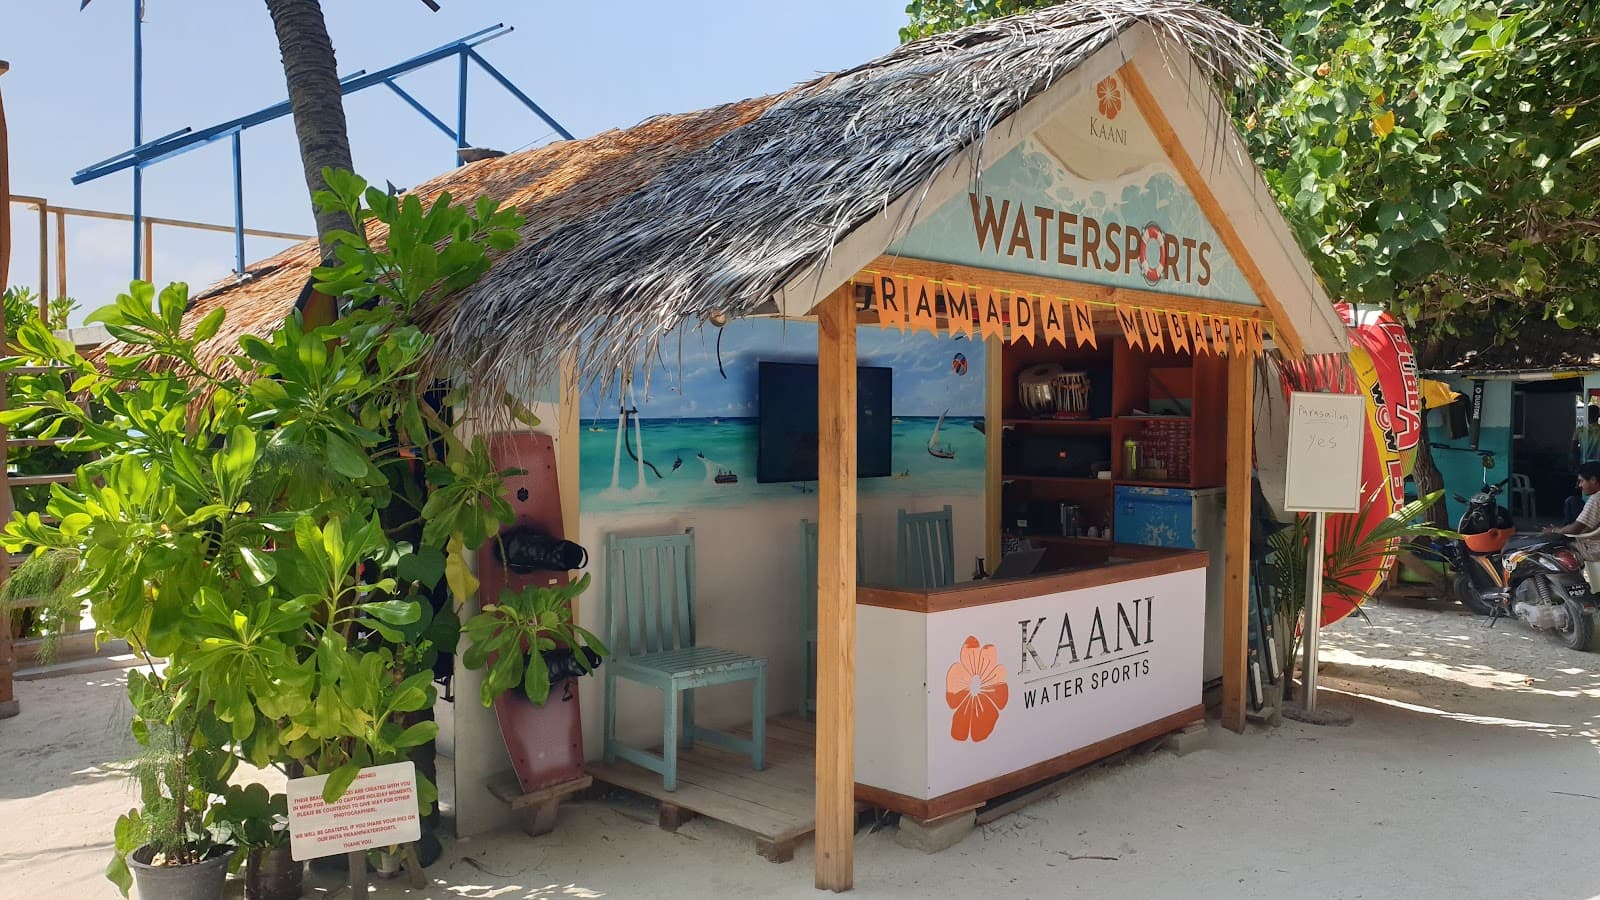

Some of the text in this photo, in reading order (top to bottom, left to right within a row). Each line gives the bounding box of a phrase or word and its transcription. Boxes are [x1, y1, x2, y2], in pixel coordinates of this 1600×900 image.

[1089, 116, 1128, 146] KAANI
[969, 192, 1212, 288] WATERSPORTS
[881, 276, 1263, 345] RAMADAN MUBARAK
[1370, 381, 1399, 452] WOW
[1018, 596, 1155, 676] KAANI
[1023, 659, 1151, 710] WATER SPORTS
